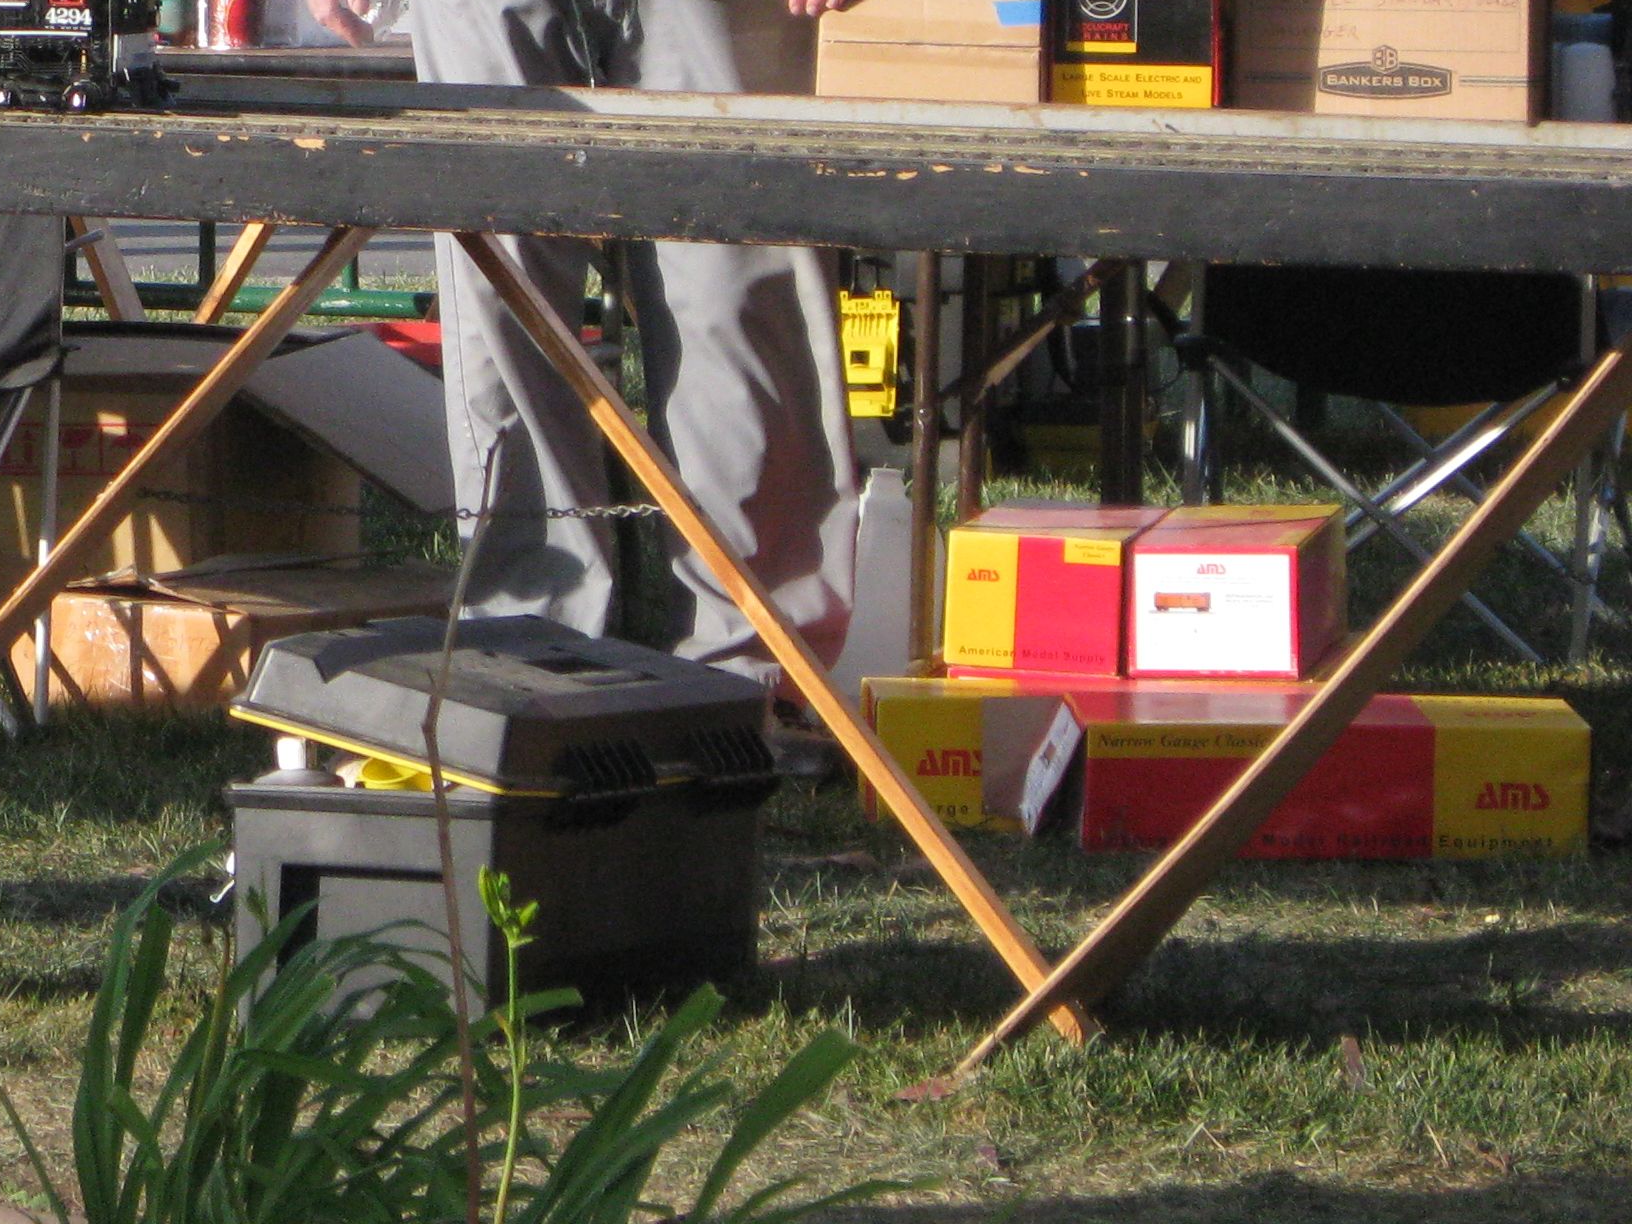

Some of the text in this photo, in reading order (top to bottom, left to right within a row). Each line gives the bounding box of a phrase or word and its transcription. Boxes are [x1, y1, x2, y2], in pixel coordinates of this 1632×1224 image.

[45, 7, 93, 26] 4294
[1099, 72, 1131, 83] SCALE
[1183, 75, 1202, 84] AND
[1326, 75, 1444, 88] BANKERS BOX
[1106, 89, 1139, 99] STEAM
[1143, 90, 1183, 100] MODELS
[958, 645, 1107, 666] American Model Supply
[1096, 733, 1156, 751] Narrow
[1159, 734, 1210, 753] Gauge
[1474, 782, 1552, 811] AMS
[1437, 835, 1555, 853] Equipment
